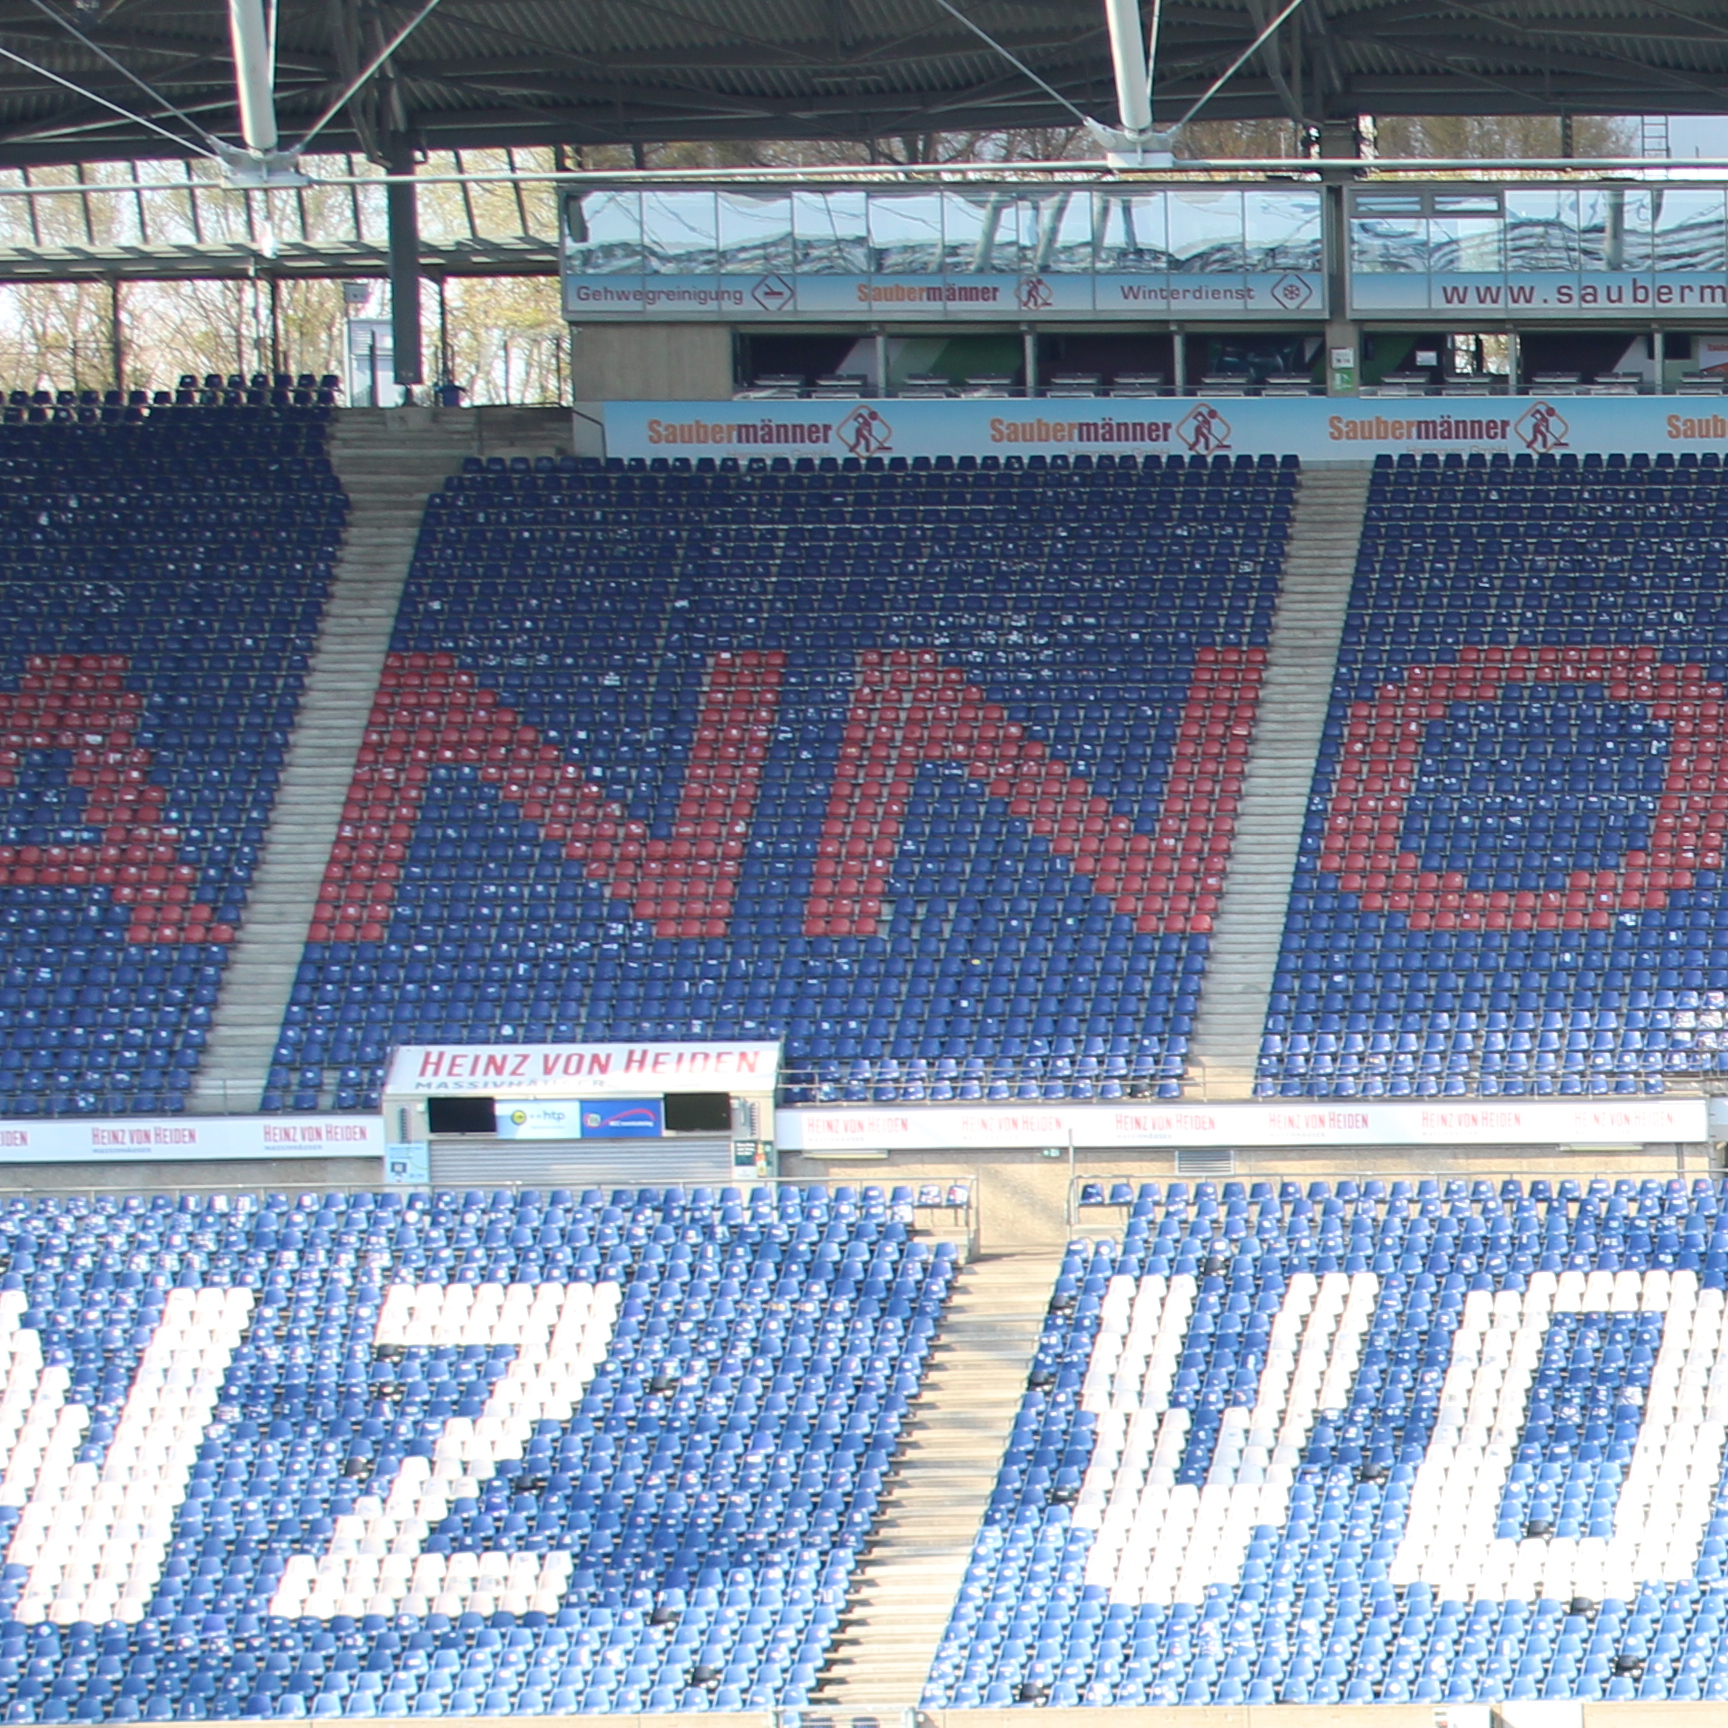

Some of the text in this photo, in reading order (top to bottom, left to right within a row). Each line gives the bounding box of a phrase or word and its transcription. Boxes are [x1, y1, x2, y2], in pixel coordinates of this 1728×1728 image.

[576, 285, 744, 305] Gehwegreinigung
[857, 282, 999, 302] Saubermänner
[1120, 284, 1255, 301] Winterdienst
[647, 418, 832, 445] Saubermänner
[990, 417, 1172, 443] Saubermänner
[1328, 415, 1510, 441] Saubermänner
[418, 1048, 760, 1077] HEINZ VON HEIDEN
[807, 1116, 909, 1136] HEINZ VON HEIDEN
[1115, 1113, 1216, 1132] HEINZ VON HEIDEN
[1269, 1111, 1369, 1130] HEINZ VON HEIDEN
[92, 1126, 197, 1145] HEINZ VON HEIDEN
[263, 1123, 368, 1144] HEINZ VON HEIDEN
